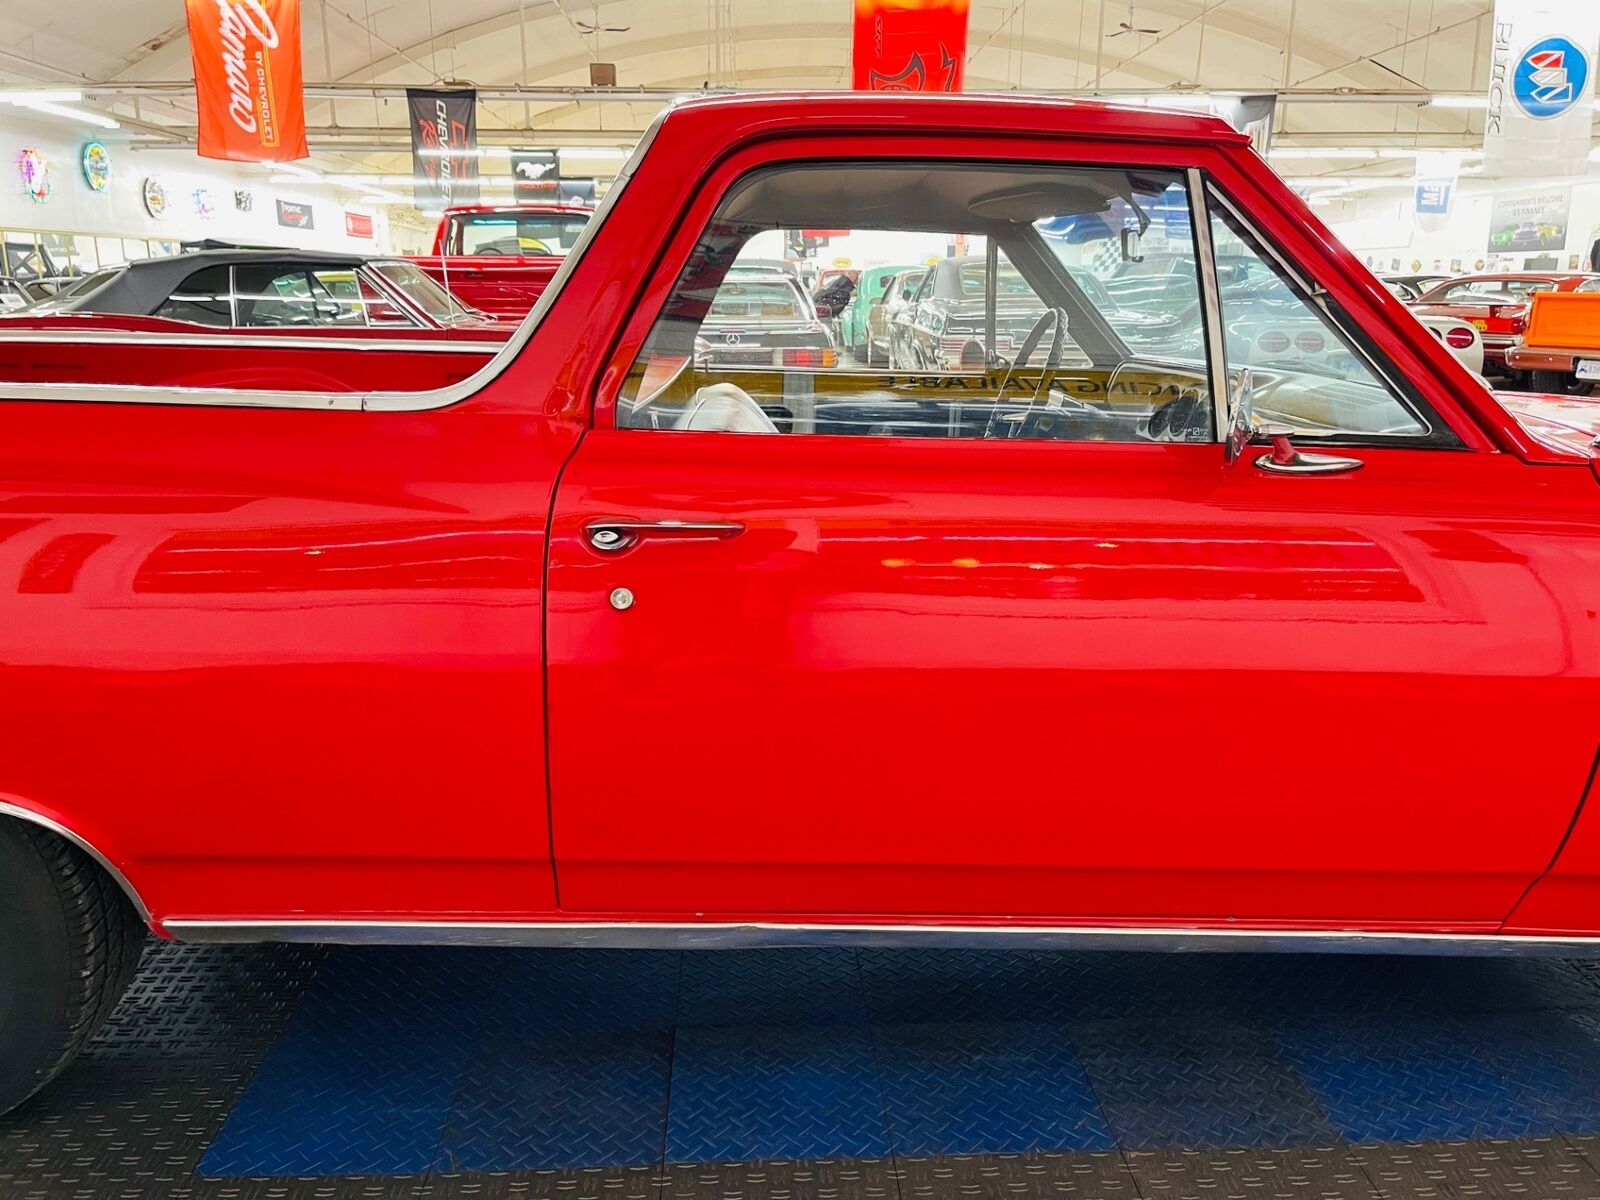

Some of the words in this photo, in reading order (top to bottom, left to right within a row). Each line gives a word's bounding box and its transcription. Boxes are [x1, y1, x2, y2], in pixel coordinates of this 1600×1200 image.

[255, 51, 264, 65] BY
[1488, 22, 1512, 134] BUICK
[257, 68, 273, 141] CHEVROLET
